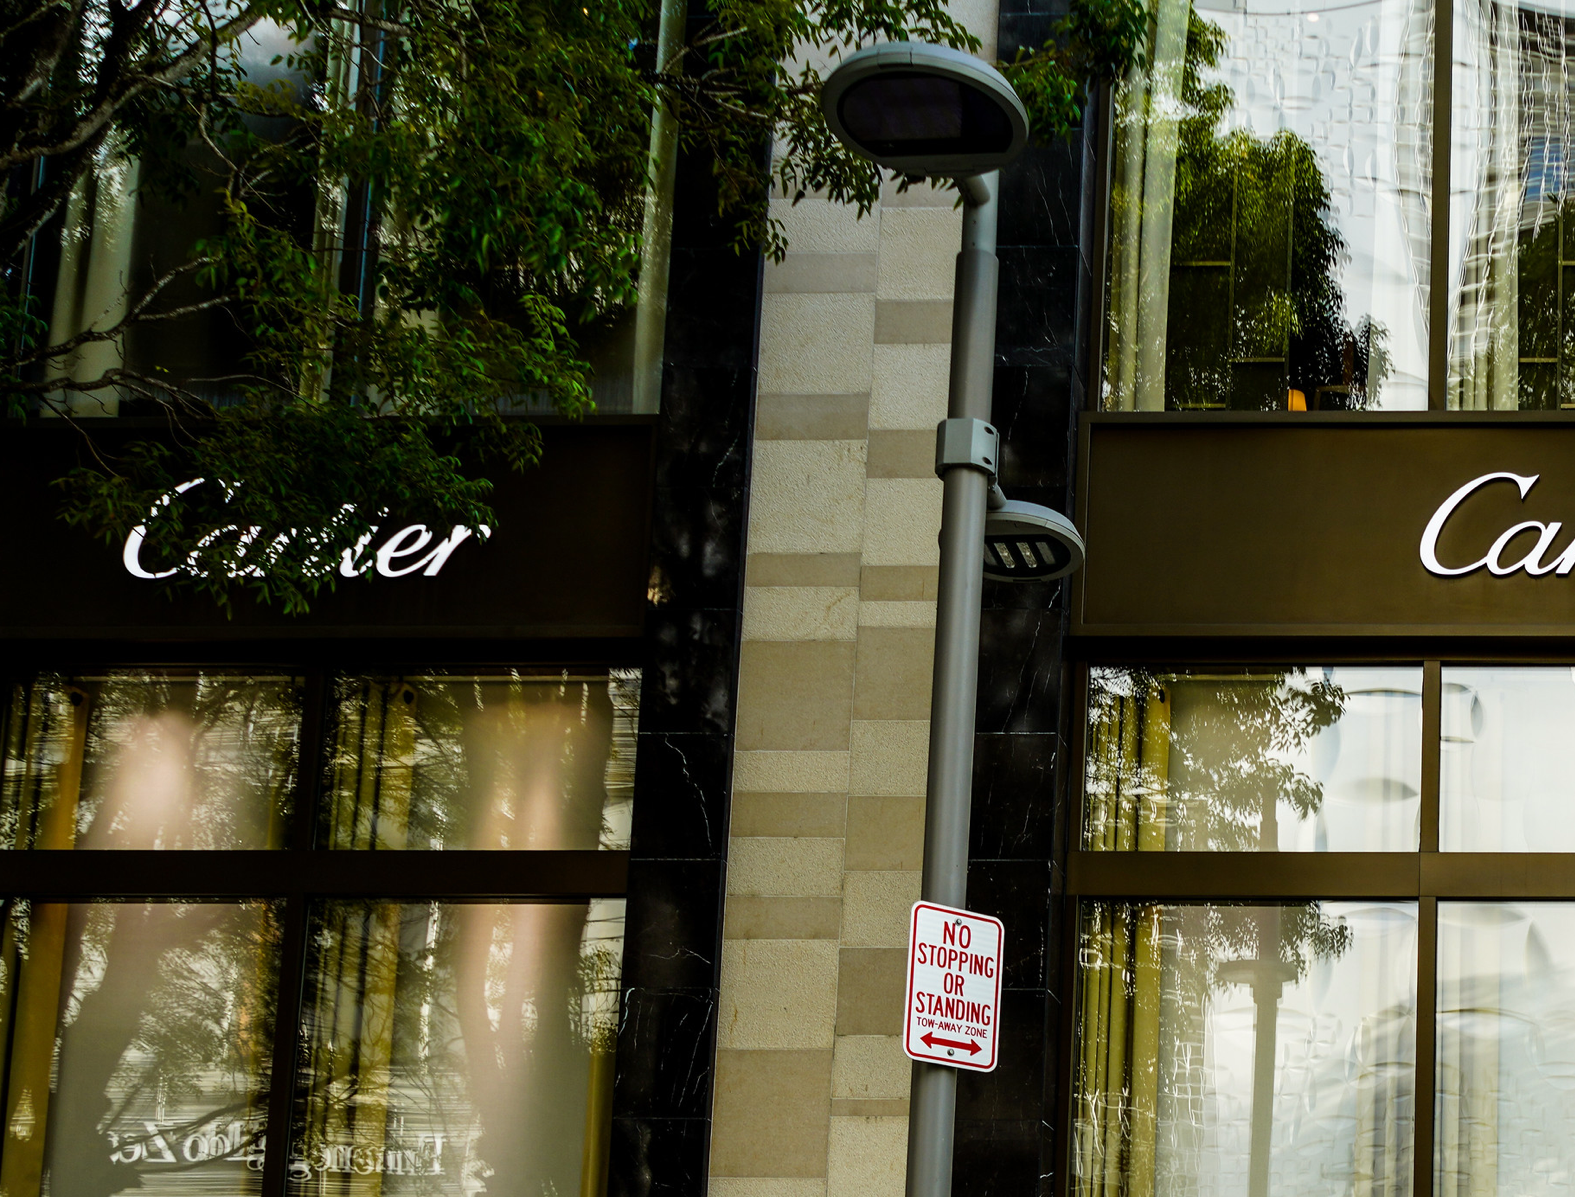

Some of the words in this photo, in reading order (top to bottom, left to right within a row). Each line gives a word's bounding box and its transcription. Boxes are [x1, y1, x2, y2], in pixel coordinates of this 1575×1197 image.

[943, 921, 972, 949] NO
[917, 942, 994, 979] STOPPING
[943, 972, 965, 997] OR
[915, 991, 991, 1026] STANDING
[916, 1016, 963, 1034] TOW-AWAY
[964, 1025, 988, 1039] ZONE
